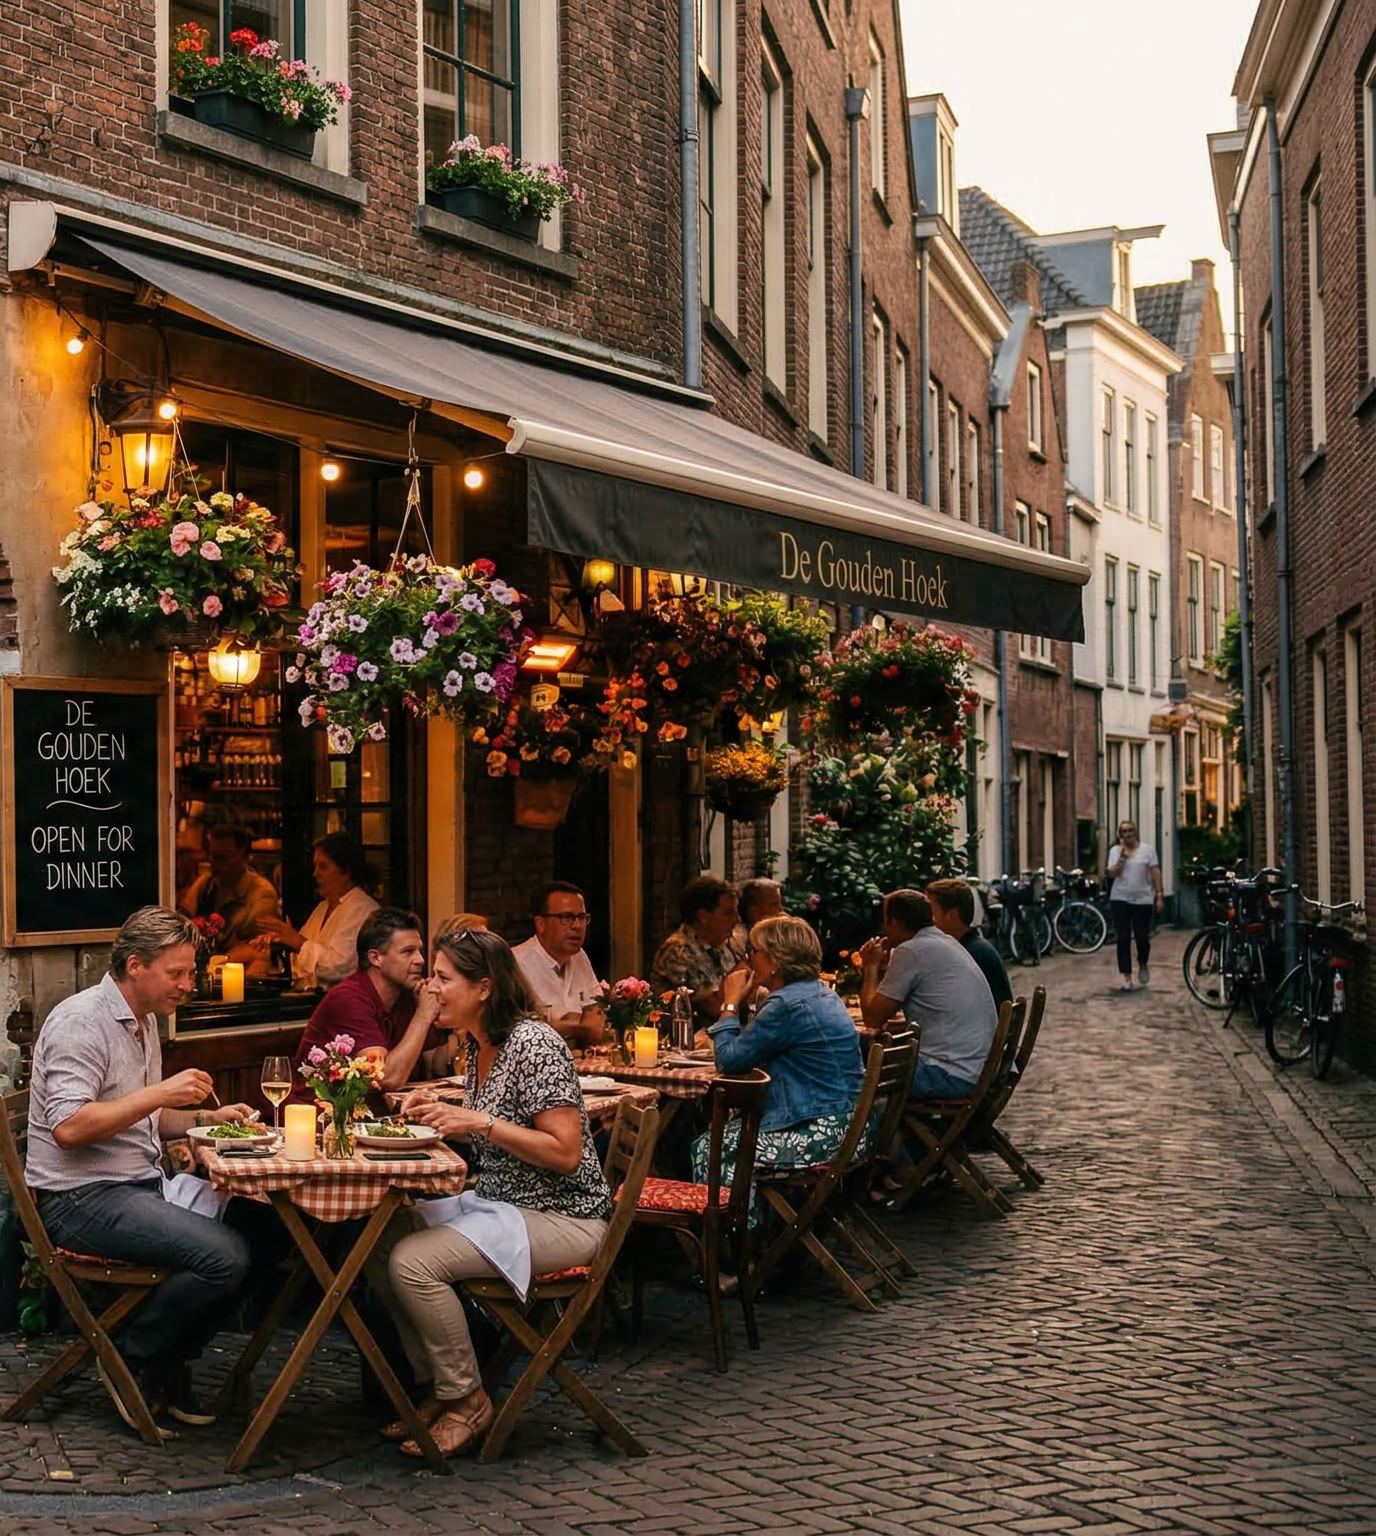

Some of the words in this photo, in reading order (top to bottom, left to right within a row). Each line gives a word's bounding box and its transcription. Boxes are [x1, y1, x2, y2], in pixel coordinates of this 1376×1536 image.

[779, 531, 812, 584] De
[817, 541, 895, 599] Gouden
[900, 558, 949, 609] Hoek
[65, 699, 97, 727] DE
[38, 731, 126, 761] GOUDEN
[55, 766, 112, 794] HOEK
[31, 825, 86, 853] OPEN
[97, 825, 135, 852] FOR
[46, 860, 124, 891] DINNER
